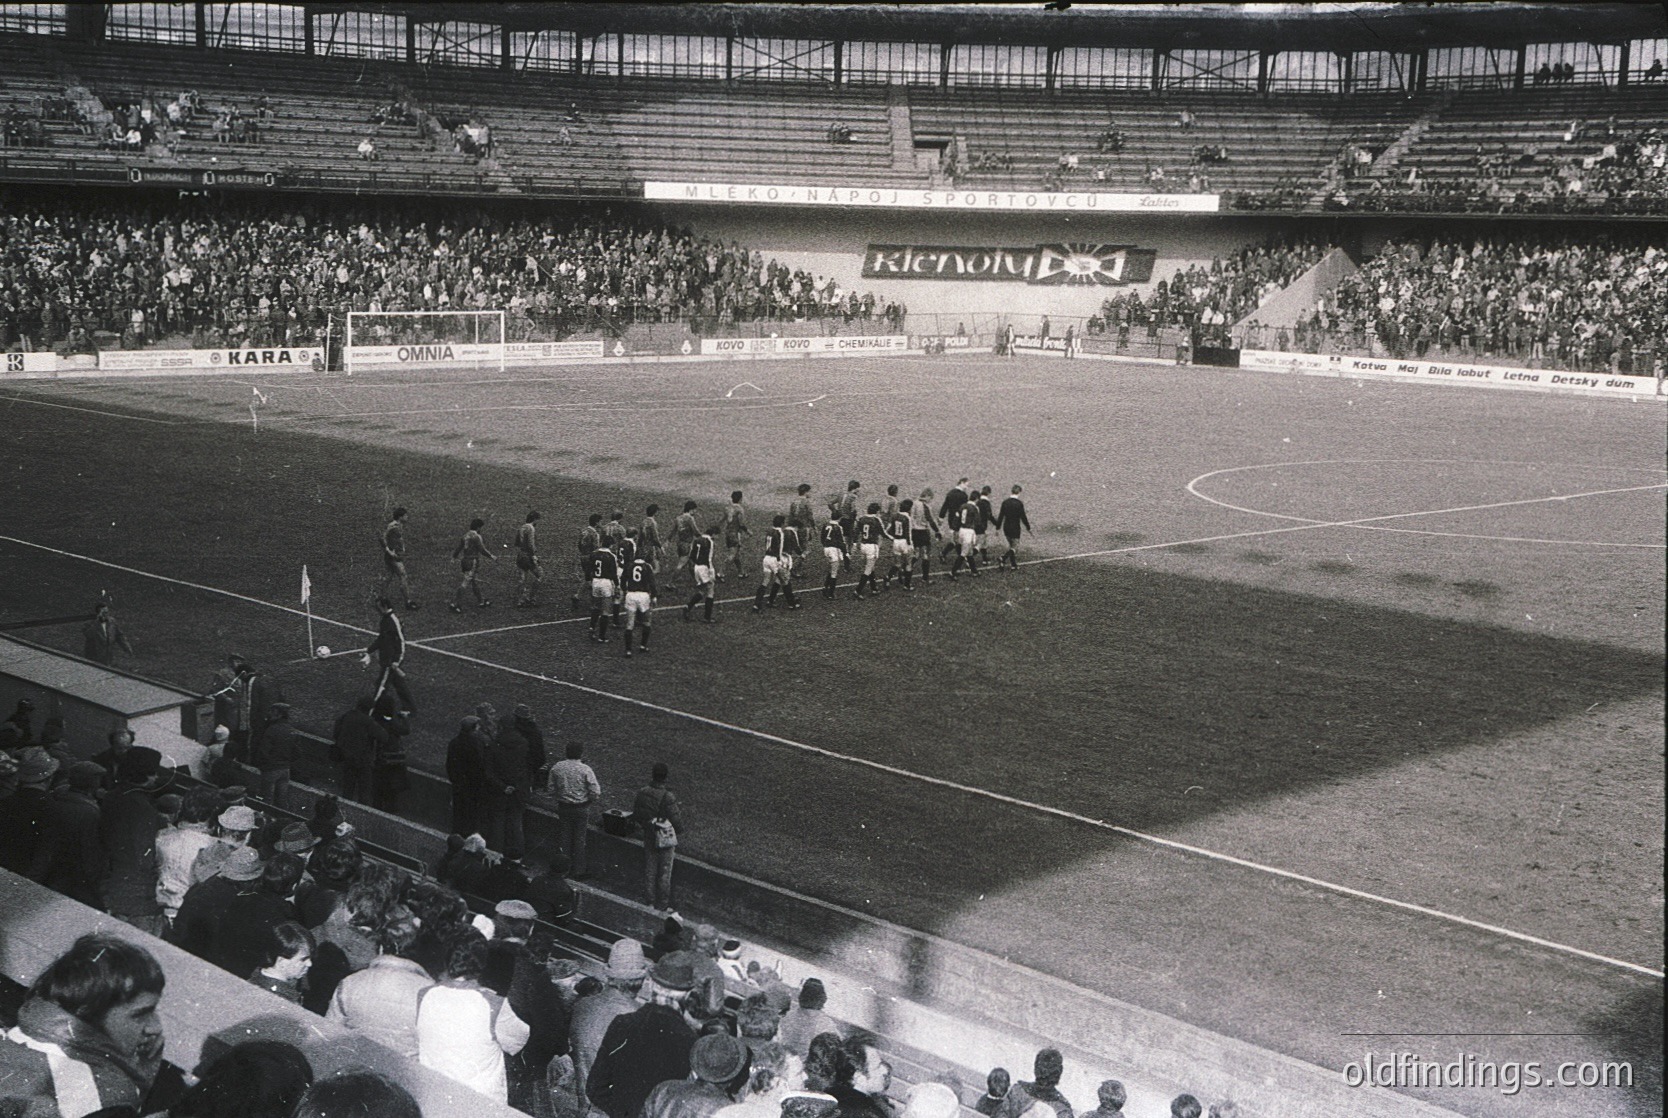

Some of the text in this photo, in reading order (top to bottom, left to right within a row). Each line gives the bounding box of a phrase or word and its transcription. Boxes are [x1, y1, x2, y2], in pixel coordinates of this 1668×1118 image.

[715, 340, 745, 351] KOVO
[782, 339, 811, 350] KOVO
[944, 336, 969, 347] POLDI
[228, 350, 293, 366] KARA
[397, 346, 455, 362] OMNIA
[1352, 361, 1388, 372] Kotva
[825, 525, 833, 540] 2
[862, 524, 870, 540] 9
[594, 560, 602, 577] 3
[632, 565, 643, 582] 6
